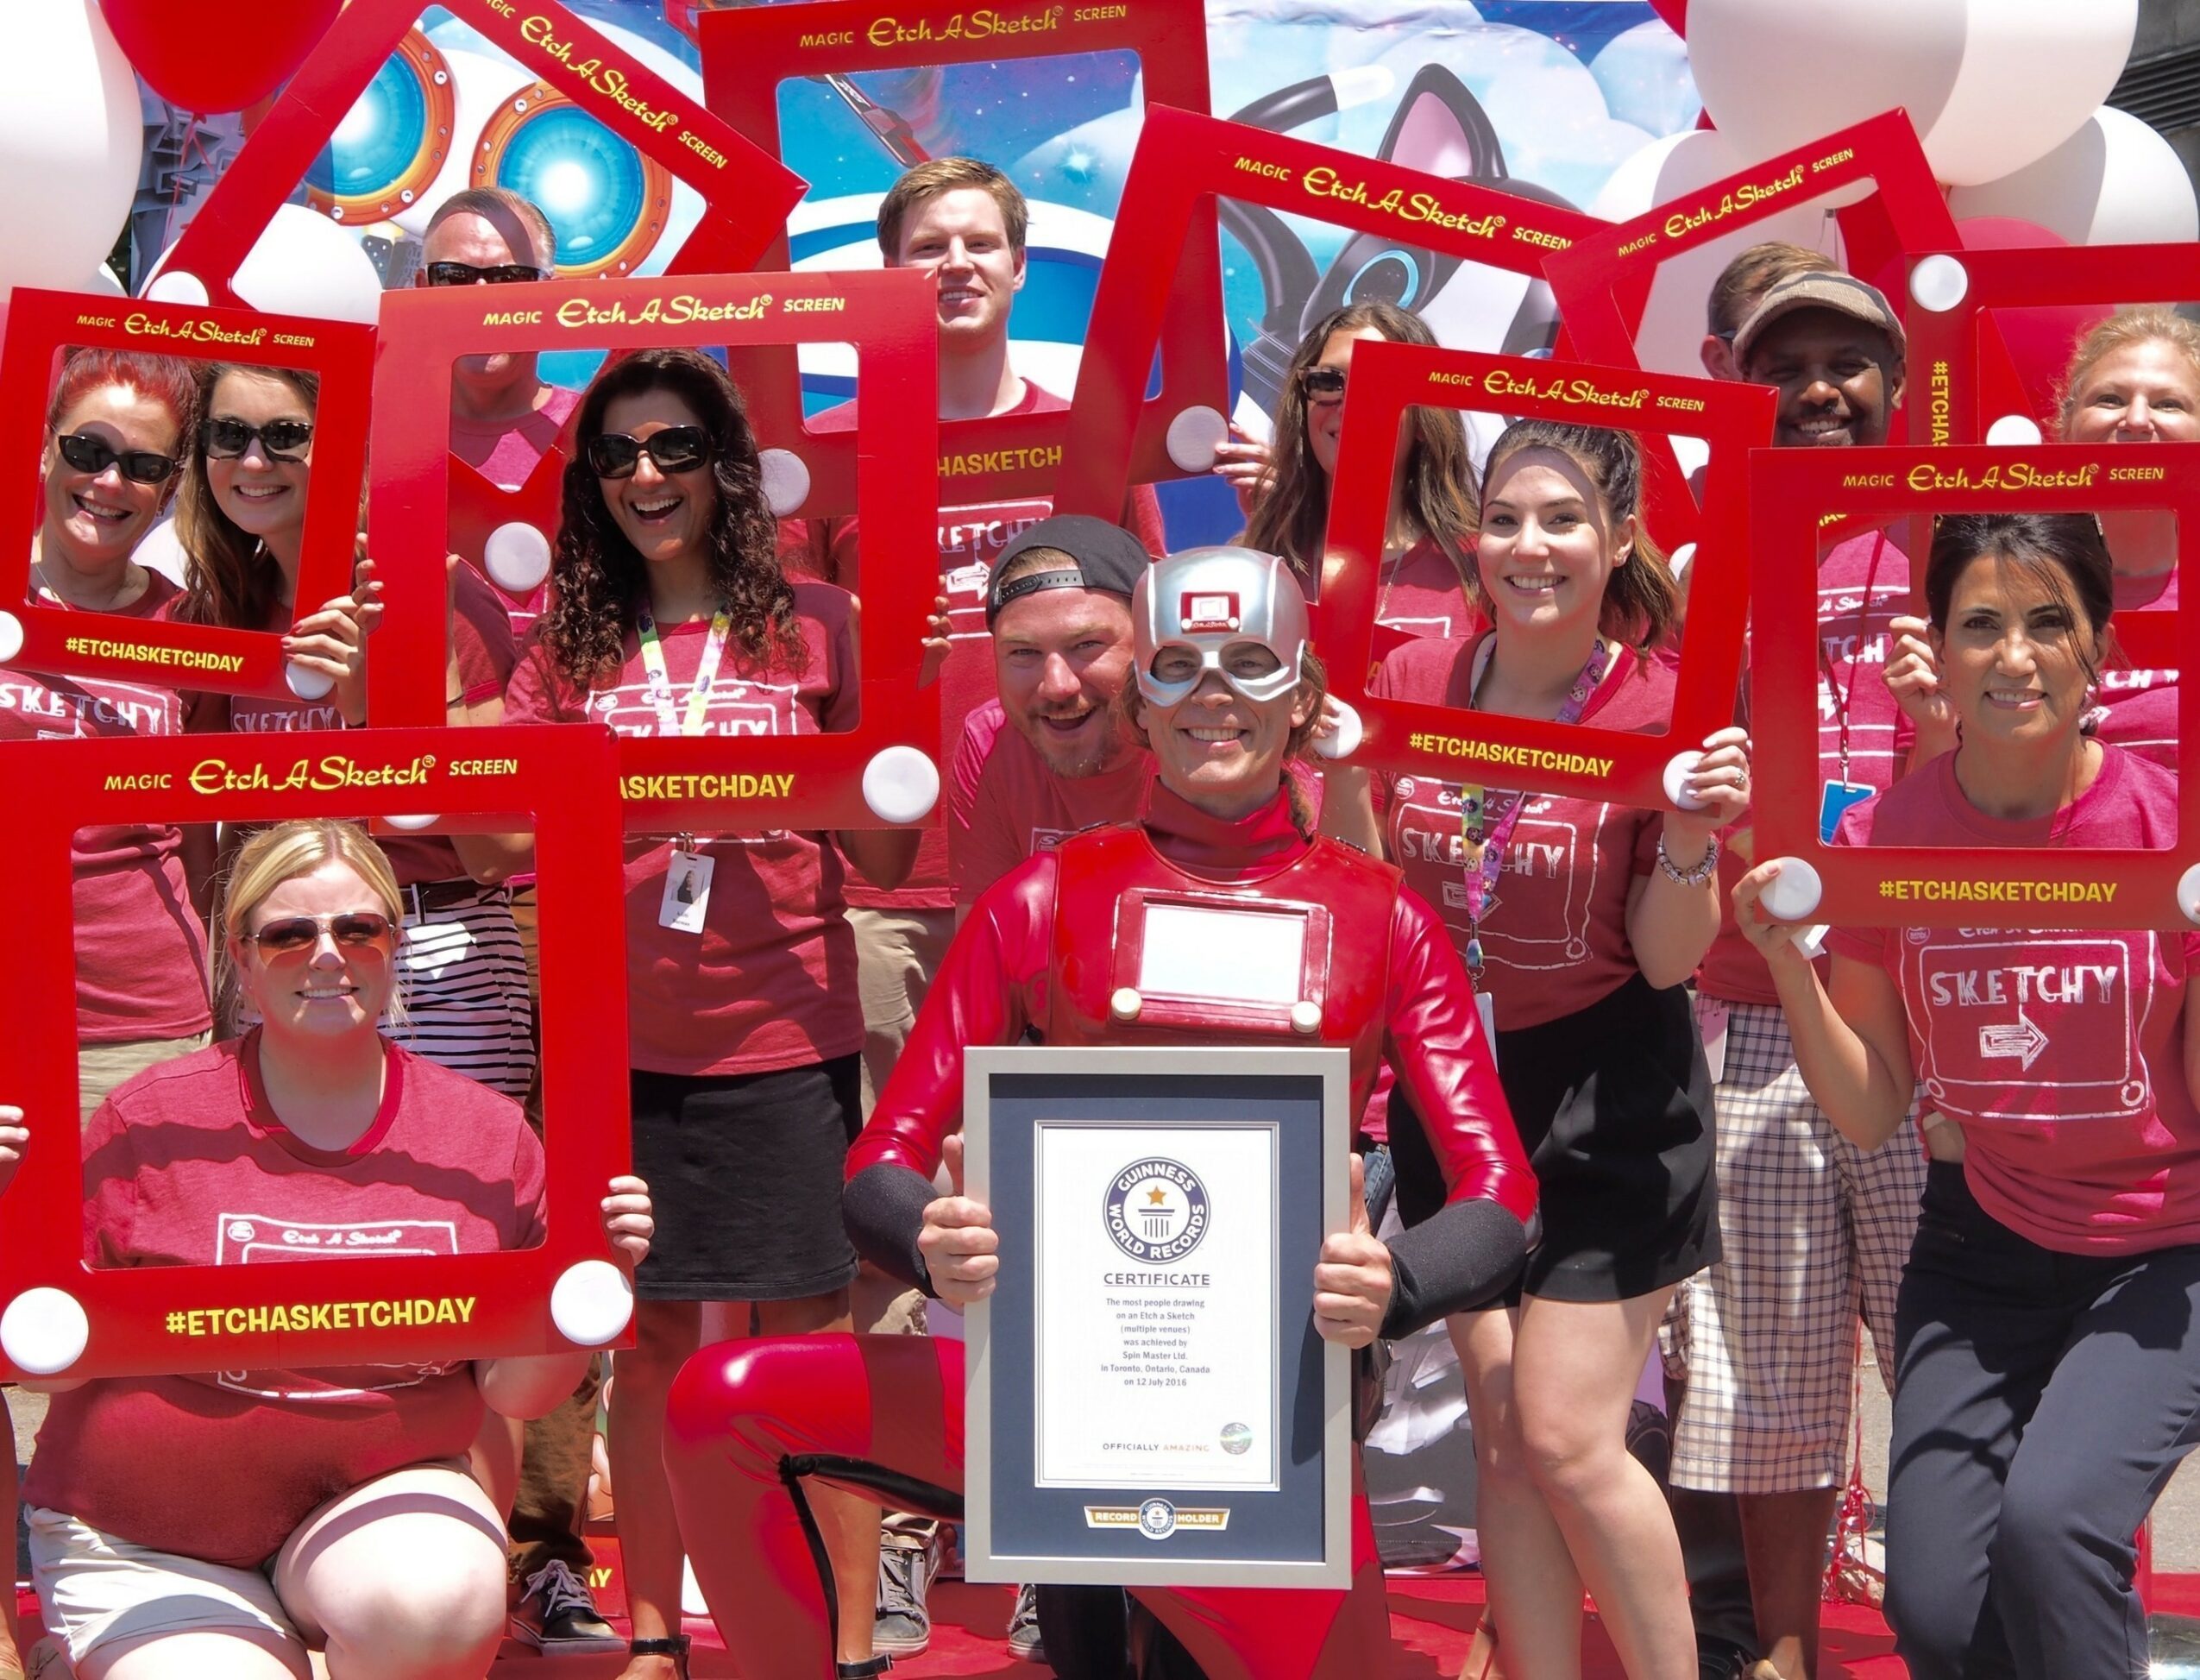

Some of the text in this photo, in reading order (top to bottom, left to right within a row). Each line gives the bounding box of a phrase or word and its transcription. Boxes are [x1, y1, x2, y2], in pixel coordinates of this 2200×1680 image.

[798, 31, 855, 48] MAGIC
[866, 16, 933, 47] Etch
[933, 19, 963, 41] A
[1073, 4, 1128, 22] SCREEN
[519, 15, 574, 64] Etch
[566, 59, 602, 79] A
[677, 129, 729, 170] SCREEN
[1234, 156, 1292, 181] MAGIC
[1302, 166, 1367, 206] Etch
[1367, 188, 1403, 214] A
[1512, 225, 1573, 251] SCREEN
[1618, 232, 1657, 257] MAGIC
[1663, 205, 1713, 238] Etch
[1713, 194, 1734, 221] A
[1812, 148, 1854, 173] SCREEN
[482, 311, 543, 326] MAGIC
[555, 298, 627, 329] Etch
[627, 298, 663, 325] A
[783, 296, 845, 313] SCREEN
[76, 313, 117, 329] MAGIC
[123, 312, 170, 337] Etch
[170, 320, 195, 340] A
[272, 333, 316, 348] SCREEN
[1428, 371, 1474, 387] MAGIC
[1483, 369, 1537, 396] Etch
[1537, 379, 1564, 400] A
[1656, 395, 1705, 412] SCREEN
[1842, 474, 1895, 488] MAGIC
[1906, 463, 1969, 492] Etch
[1971, 464, 2001, 490] A
[2109, 467, 2165, 481] SCREEN
[65, 637, 244, 673] #ETCHASKETCHDAY
[0, 683, 162, 734] SKETCHY
[1409, 733, 1614, 777] #ETCHASKETCHDAY
[104, 773, 172, 791] MAGIC
[187, 758, 273, 795] Etch
[272, 758, 310, 791] A
[448, 758, 518, 777] SCREEN
[1401, 827, 1566, 879] SKEHY
[1878, 879, 2118, 903] #ETCHASKETCHDAY
[1928, 966, 2119, 1007] SKETCHY
[1116, 1162, 1197, 1192] GUINNESS
[1108, 1203, 1205, 1260] WORLD RECORDS
[1103, 1273, 1211, 1286] CERTIFICATE
[165, 1296, 476, 1337] #ETCHASKETCHDAY
[1105, 1298, 1121, 1306] The
[1144, 1299, 1172, 1308] people
[1172, 1299, 1205, 1309] drawing
[1140, 1311, 1158, 1320] Etch
[1166, 1312, 1195, 1320] Sketch
[1120, 1324, 1191, 1335] (multiple venues)
[1141, 1338, 1177, 1347] achieved
[1179, 1338, 1188, 1348] by
[1122, 1351, 1188, 1361] Spin Master Ltd.
[1179, 1365, 1211, 1374] Canada
[1147, 1378, 1163, 1388] July
[1165, 1378, 1188, 1387] 2016
[1102, 1443, 1210, 1452] OFFICIALLY AMAZING
[1095, 1511, 1220, 1524] RECORD HOLDER
